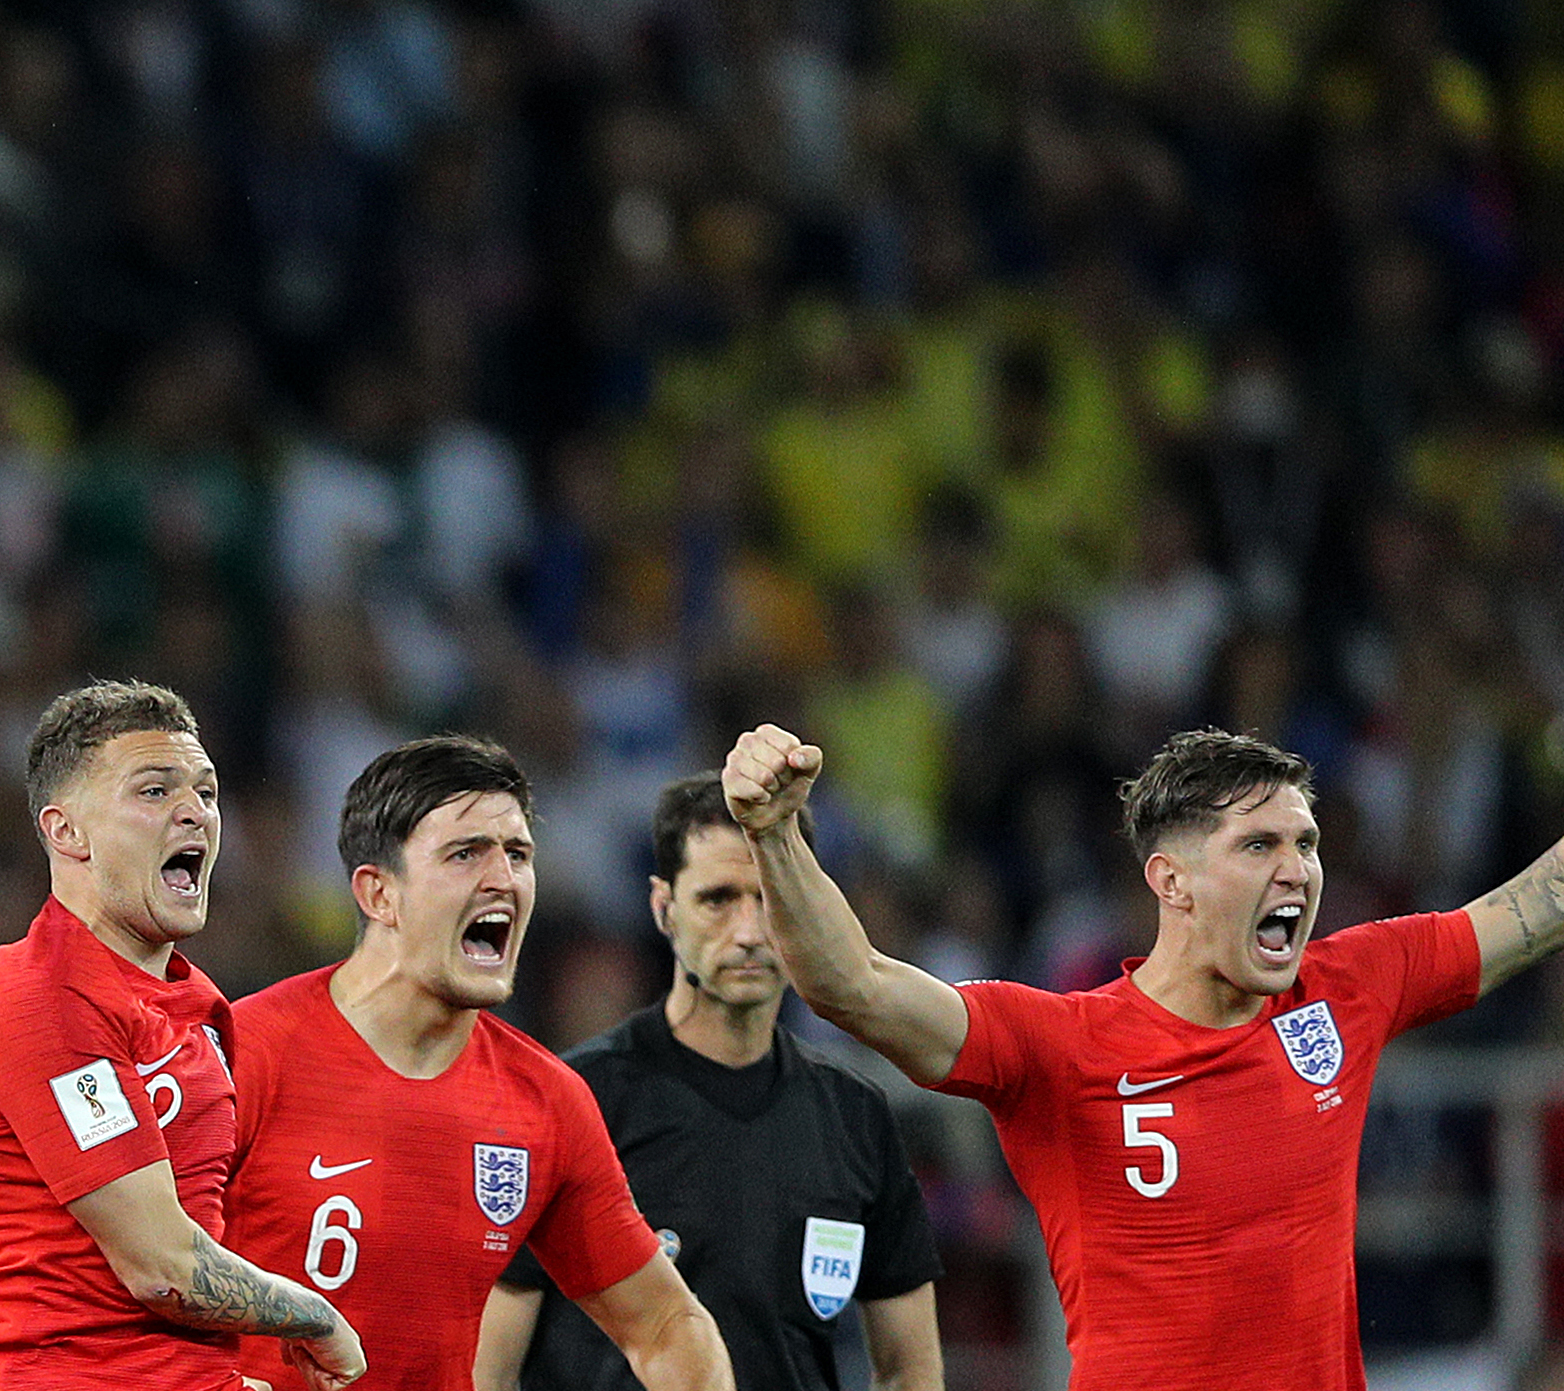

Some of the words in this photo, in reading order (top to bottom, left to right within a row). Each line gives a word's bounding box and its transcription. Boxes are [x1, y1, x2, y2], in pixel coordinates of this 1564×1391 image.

[1122, 1102, 1179, 1198] 5
[304, 1195, 362, 1291] 6
[811, 1254, 851, 1280] FIFA
